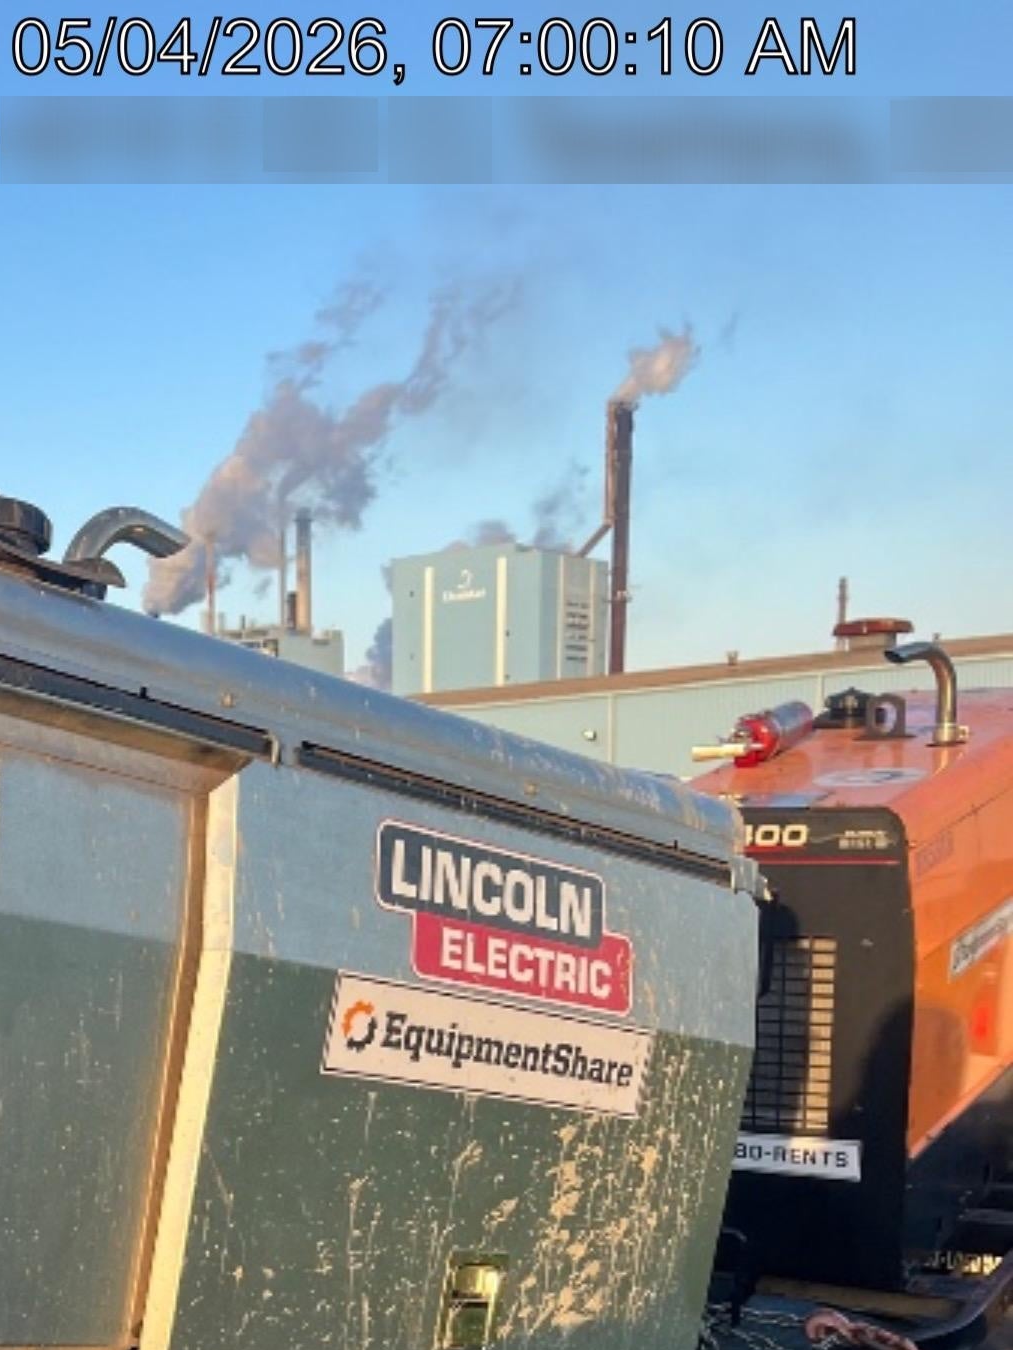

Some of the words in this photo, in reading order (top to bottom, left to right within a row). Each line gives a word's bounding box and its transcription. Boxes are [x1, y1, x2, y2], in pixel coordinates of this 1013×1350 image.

[390, 838, 592, 938] LINCOLN
[440, 926, 613, 1000] ELECTRIC
[381, 1010, 634, 1088] EquipmentShare
